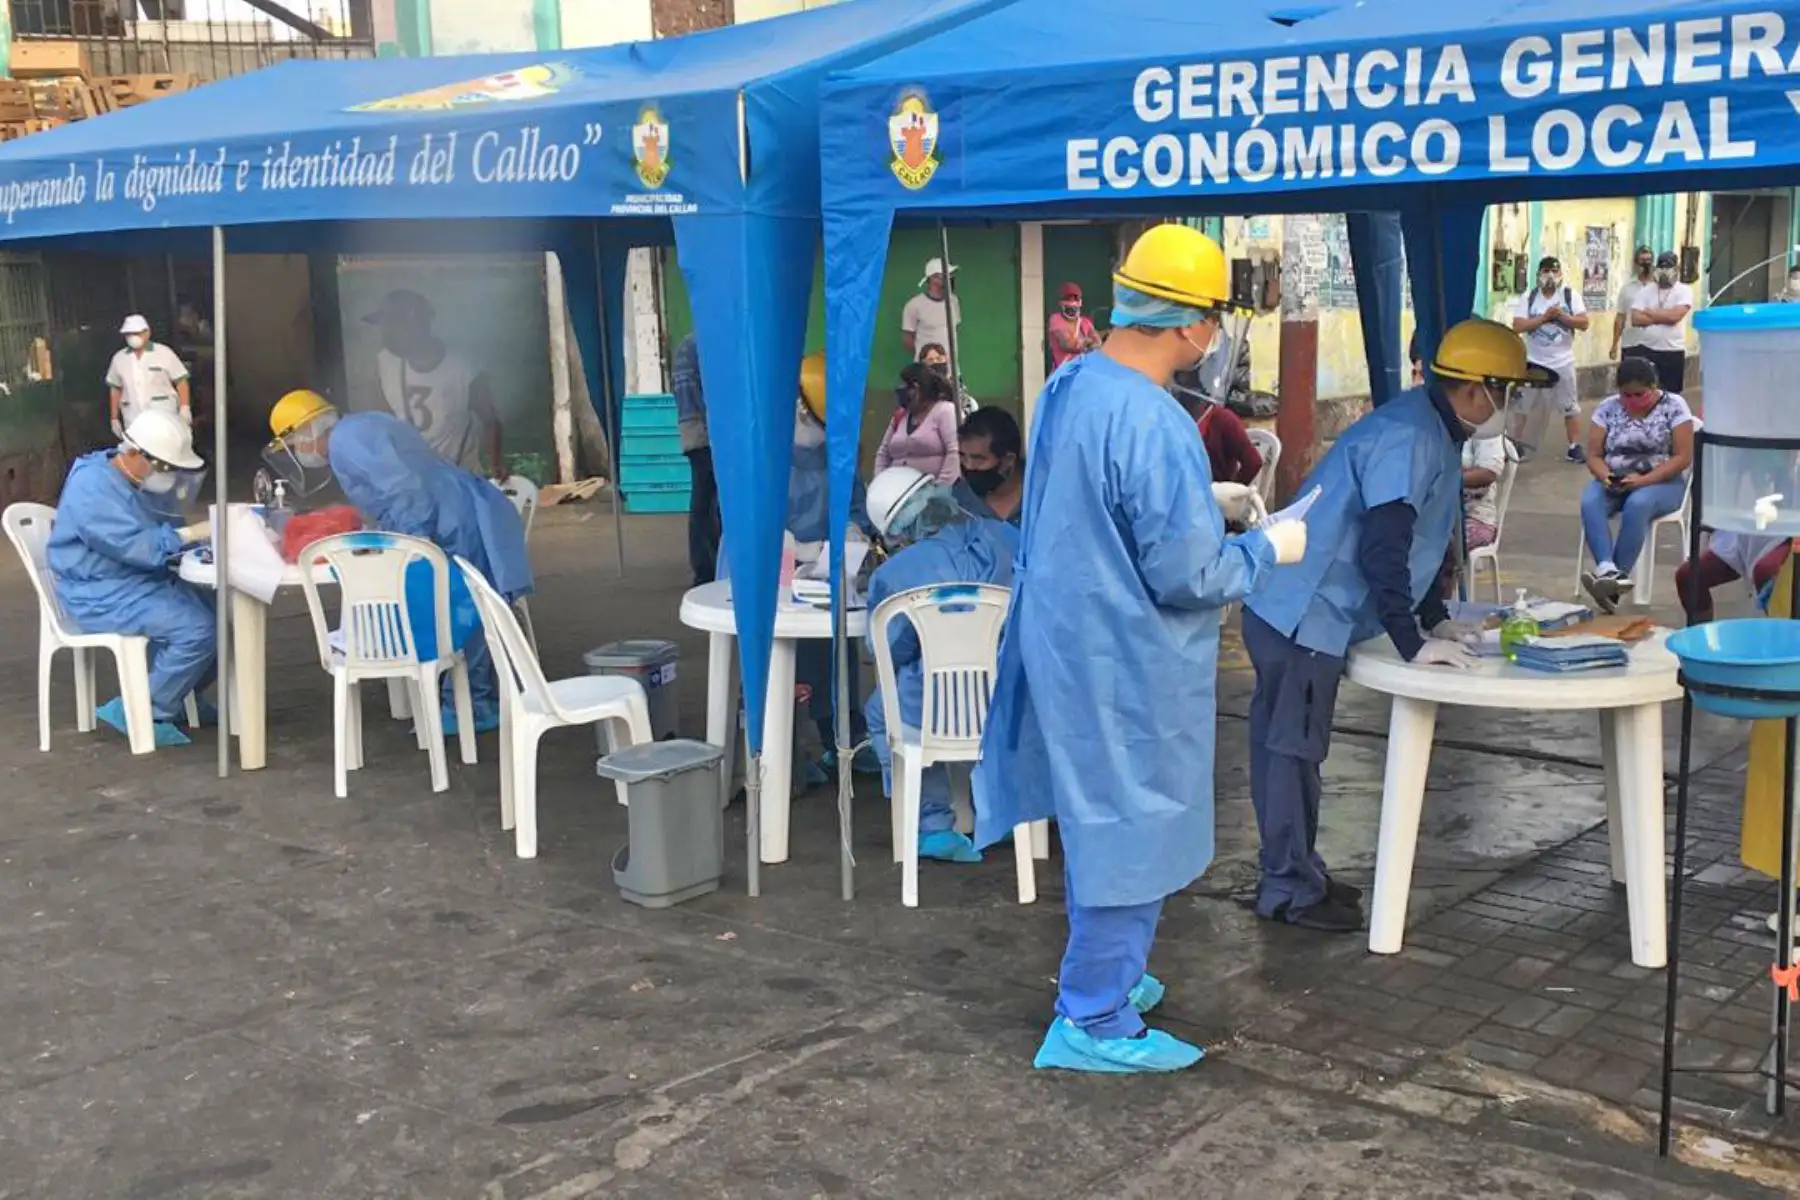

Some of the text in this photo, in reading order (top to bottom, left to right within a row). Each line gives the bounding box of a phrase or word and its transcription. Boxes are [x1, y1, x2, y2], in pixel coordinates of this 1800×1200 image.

[1133, 11, 1800, 123] GERENCIA GENER
[95, 158, 115, 201] la
[124, 146, 226, 212] dignidad
[236, 159, 249, 192] e
[262, 135, 398, 190] identidad
[409, 132, 457, 185] del
[899, 166, 931, 185] CALLAO
[1066, 96, 1756, 191] ECONÓMICO LOCAL
[407, 385, 433, 432] 3
